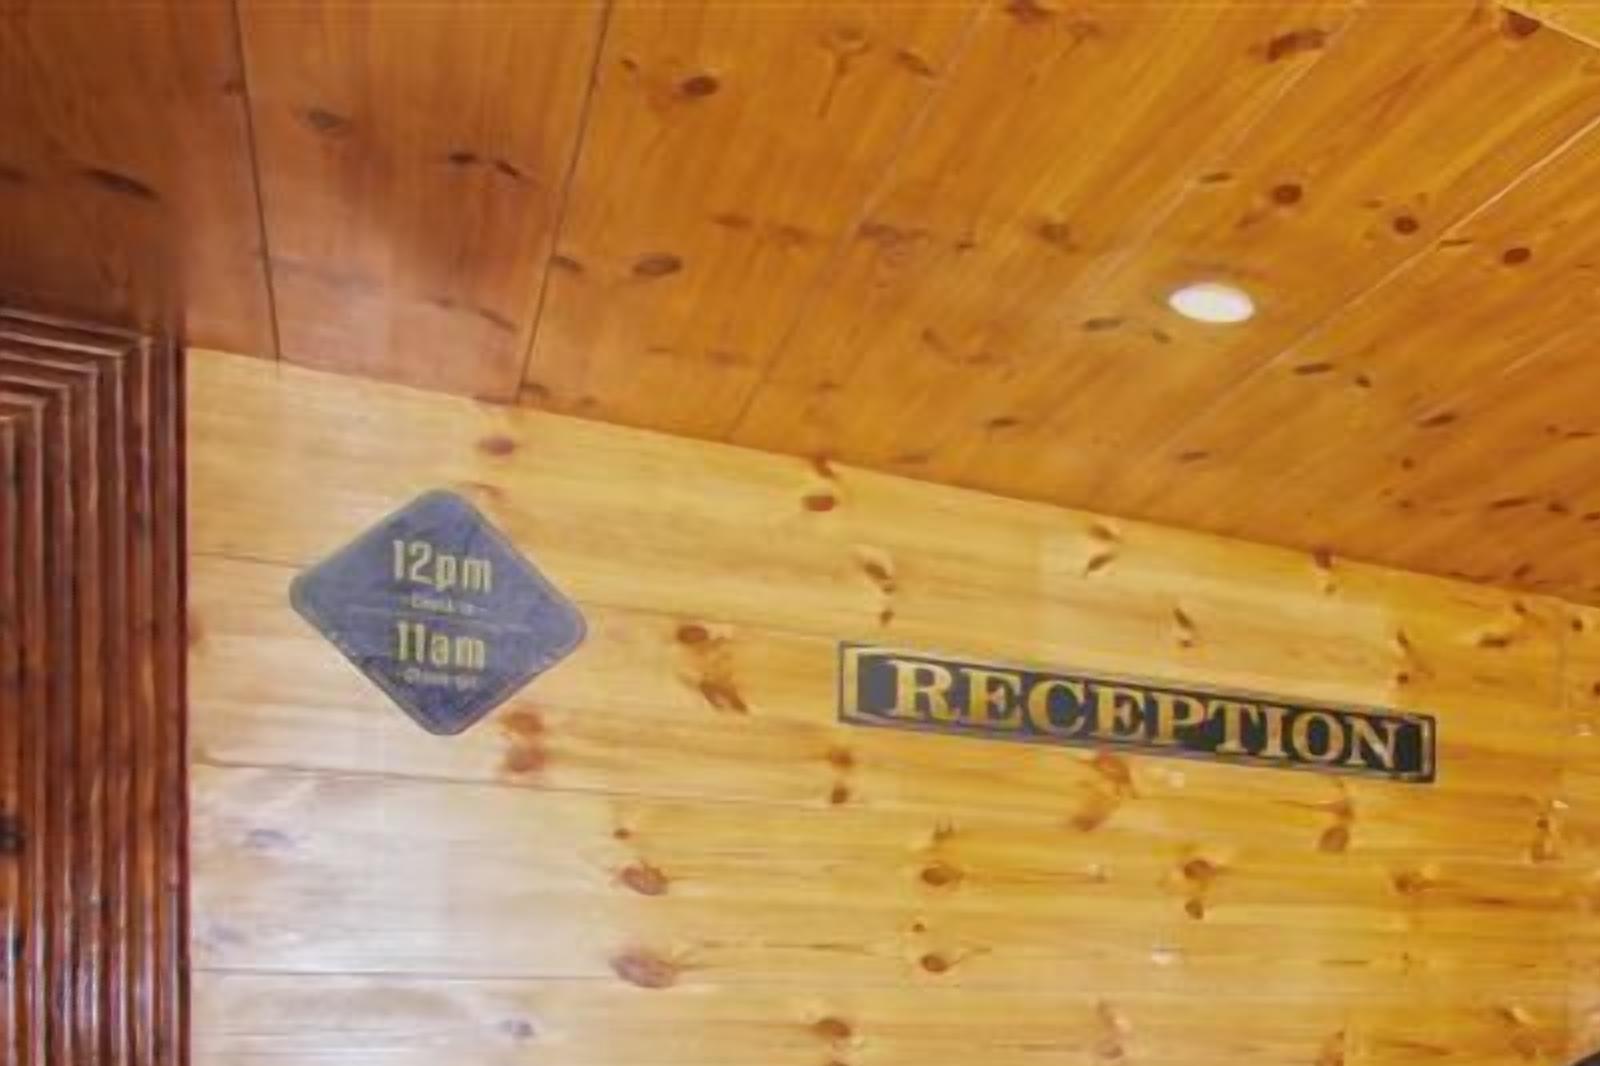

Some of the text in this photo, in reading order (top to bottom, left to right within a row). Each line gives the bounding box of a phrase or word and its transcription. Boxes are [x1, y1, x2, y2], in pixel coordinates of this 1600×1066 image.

[392, 539, 493, 593] 12pm
[397, 620, 486, 670] 11am
[887, 658, 1400, 770] RECEPTION
